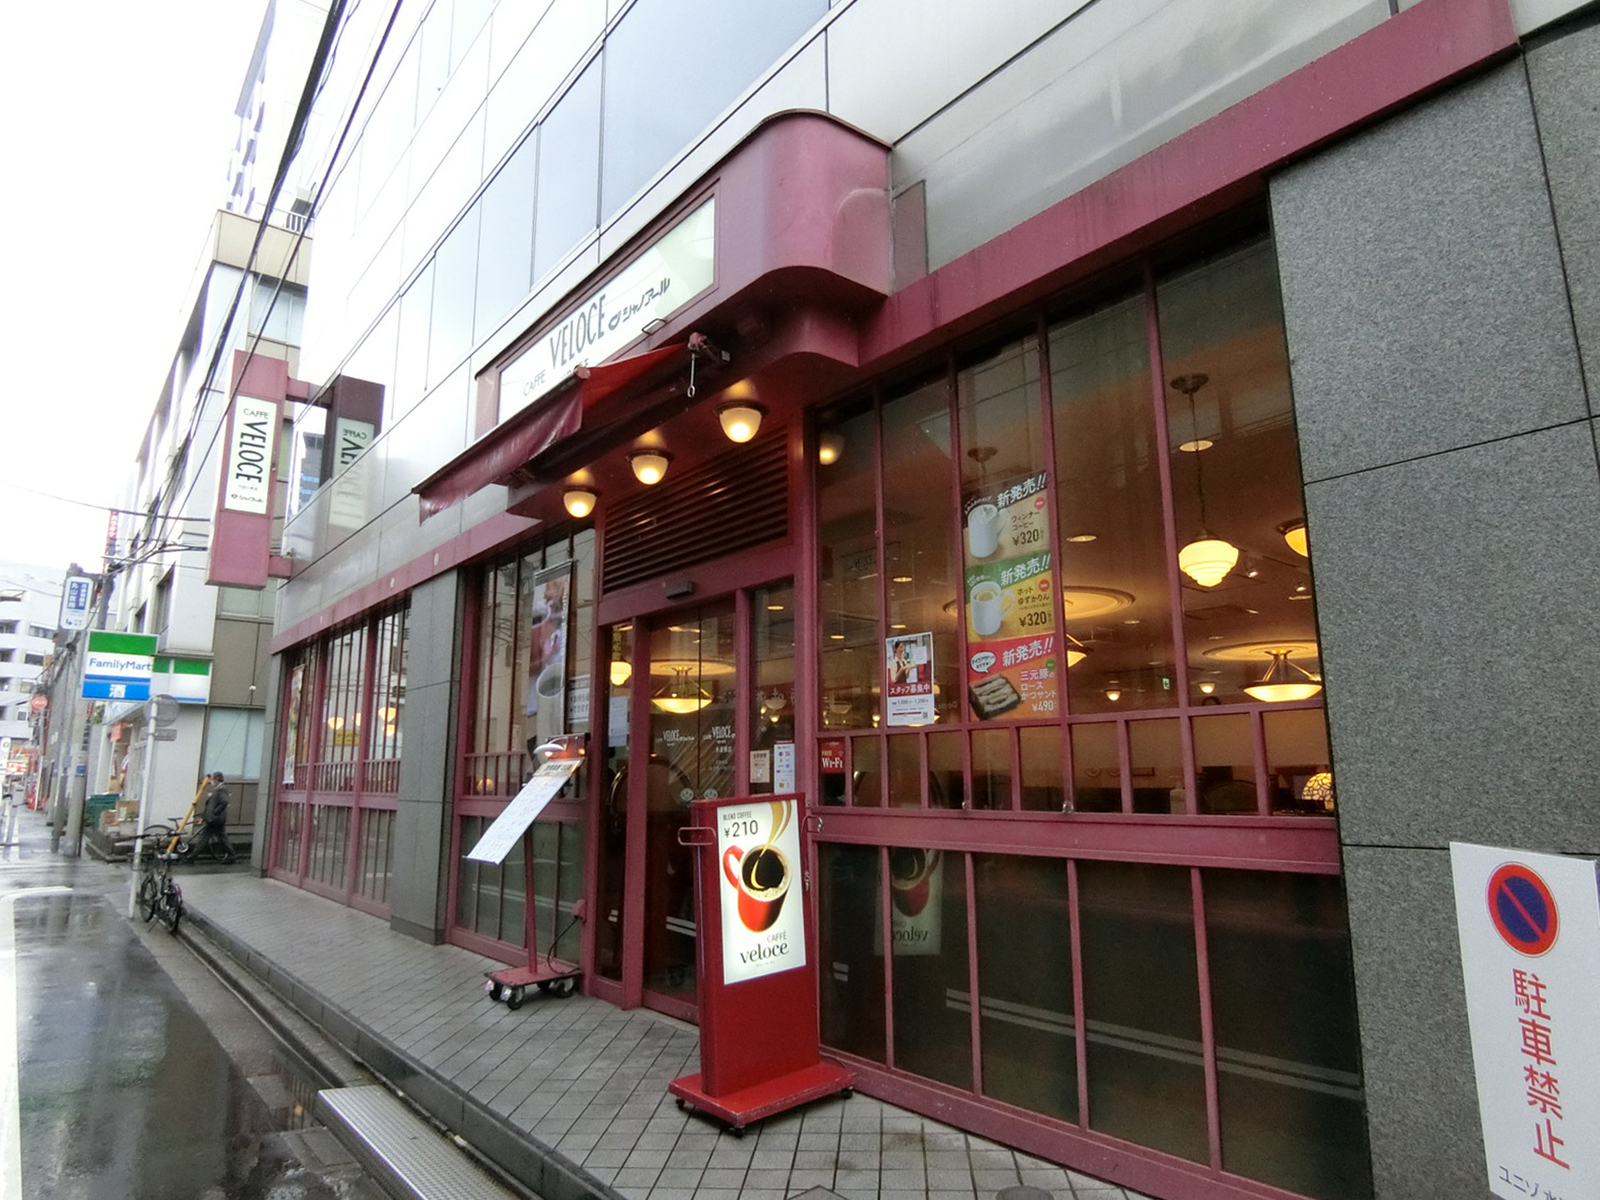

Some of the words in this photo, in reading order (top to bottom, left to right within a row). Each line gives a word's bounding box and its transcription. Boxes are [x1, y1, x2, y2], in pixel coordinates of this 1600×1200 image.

[550, 293, 606, 370] VELOCE
[243, 408, 270, 420] CAFFE
[235, 421, 268, 483] VELOCE
[1012, 521, 1034, 531] コーヒー
[89, 658, 152, 671] FamilyMart
[109, 684, 127, 698] 酒
[889, 683, 931, 695] スタッフ募集中
[1021, 681, 1044, 691] ロース
[722, 812, 736, 821] BLEND
[737, 810, 752, 820] COFFEE
[723, 819, 759, 838] ¥210
[740, 942, 790, 964] veloce
[1512, 968, 1570, 1170] 駐車禁止
